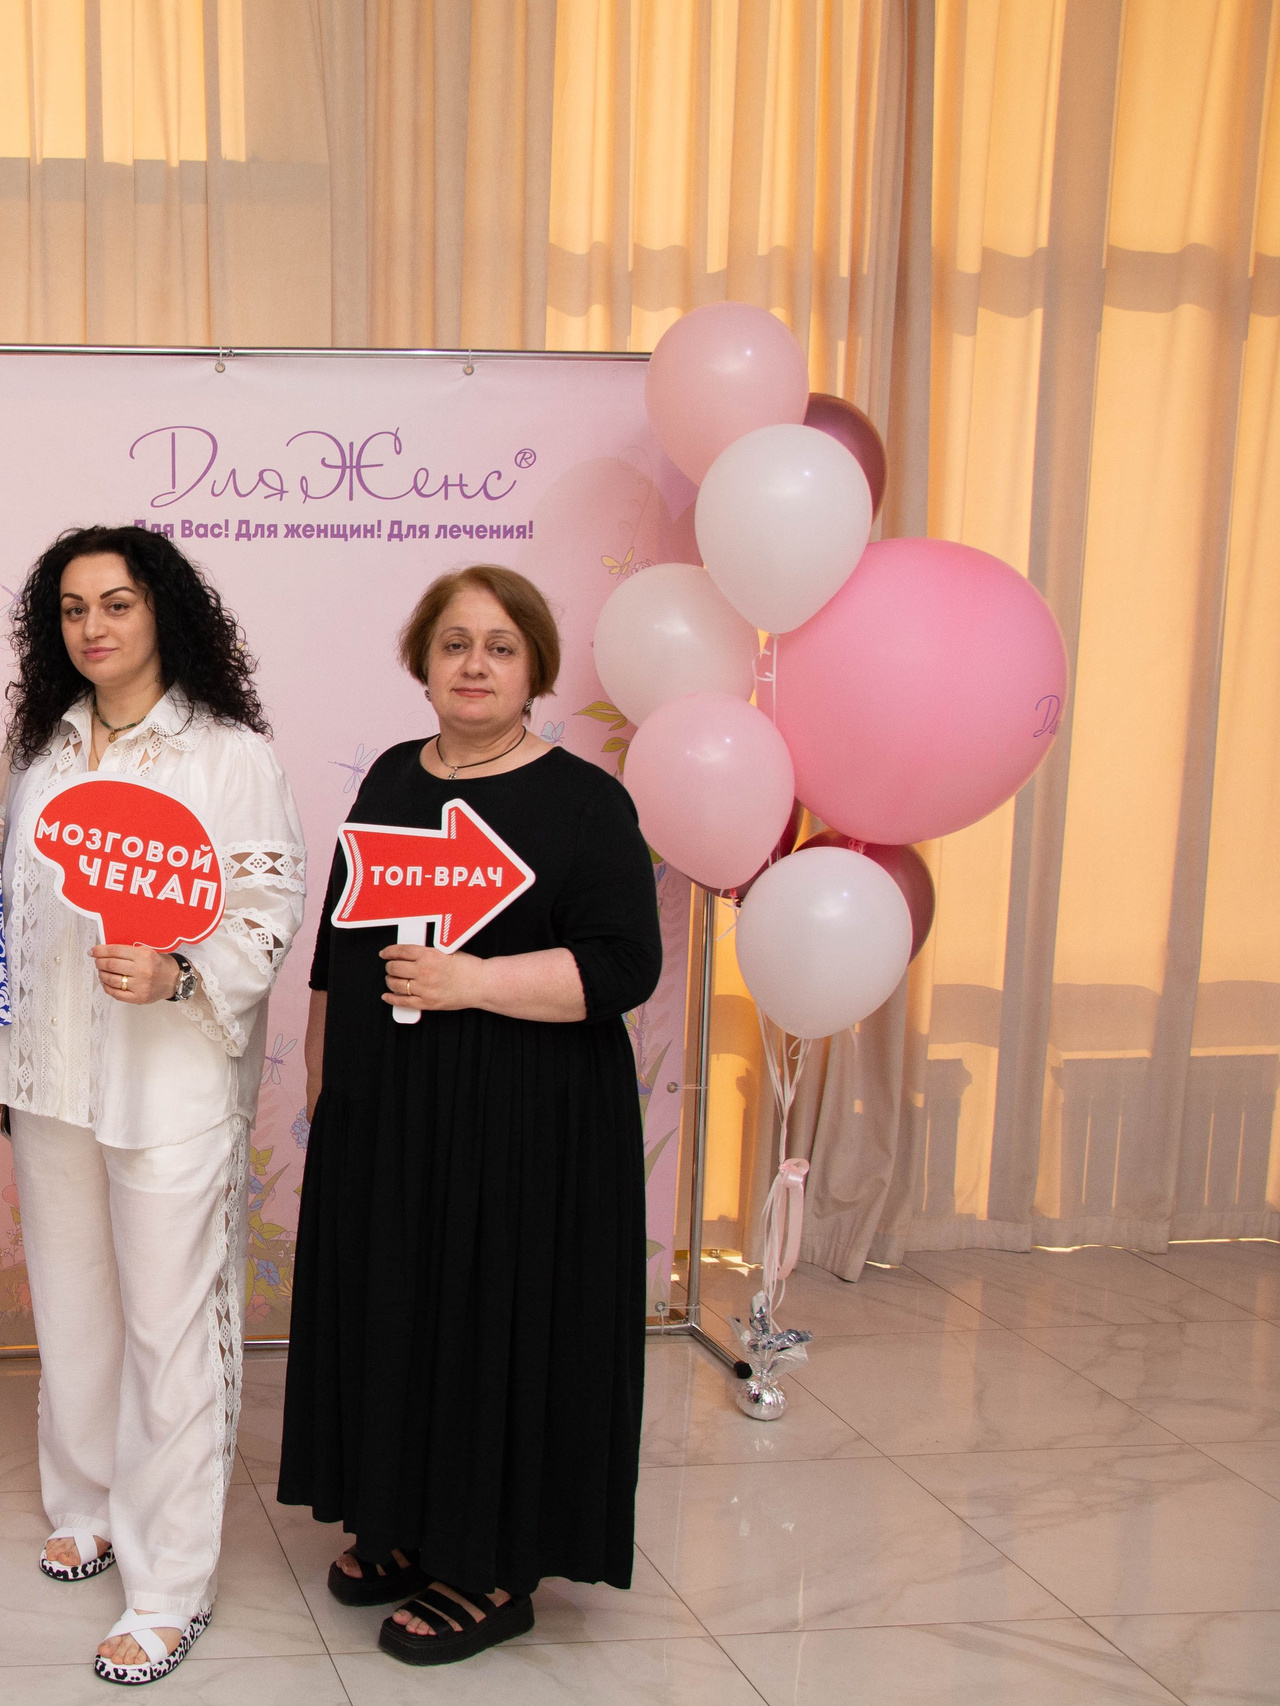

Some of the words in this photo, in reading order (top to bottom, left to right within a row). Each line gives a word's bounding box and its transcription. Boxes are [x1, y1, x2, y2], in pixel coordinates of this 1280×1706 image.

[180, 519, 230, 539] Вас!
[234, 519, 278, 541] Для
[283, 519, 382, 542] женщин!
[386, 520, 430, 542] Для
[434, 520, 535, 540] лечения!
[36, 817, 213, 874] МОЗГОВОЙ
[78, 854, 218, 911] ЧЕКАП
[370, 865, 503, 888] ТОП-ВРАЧ
